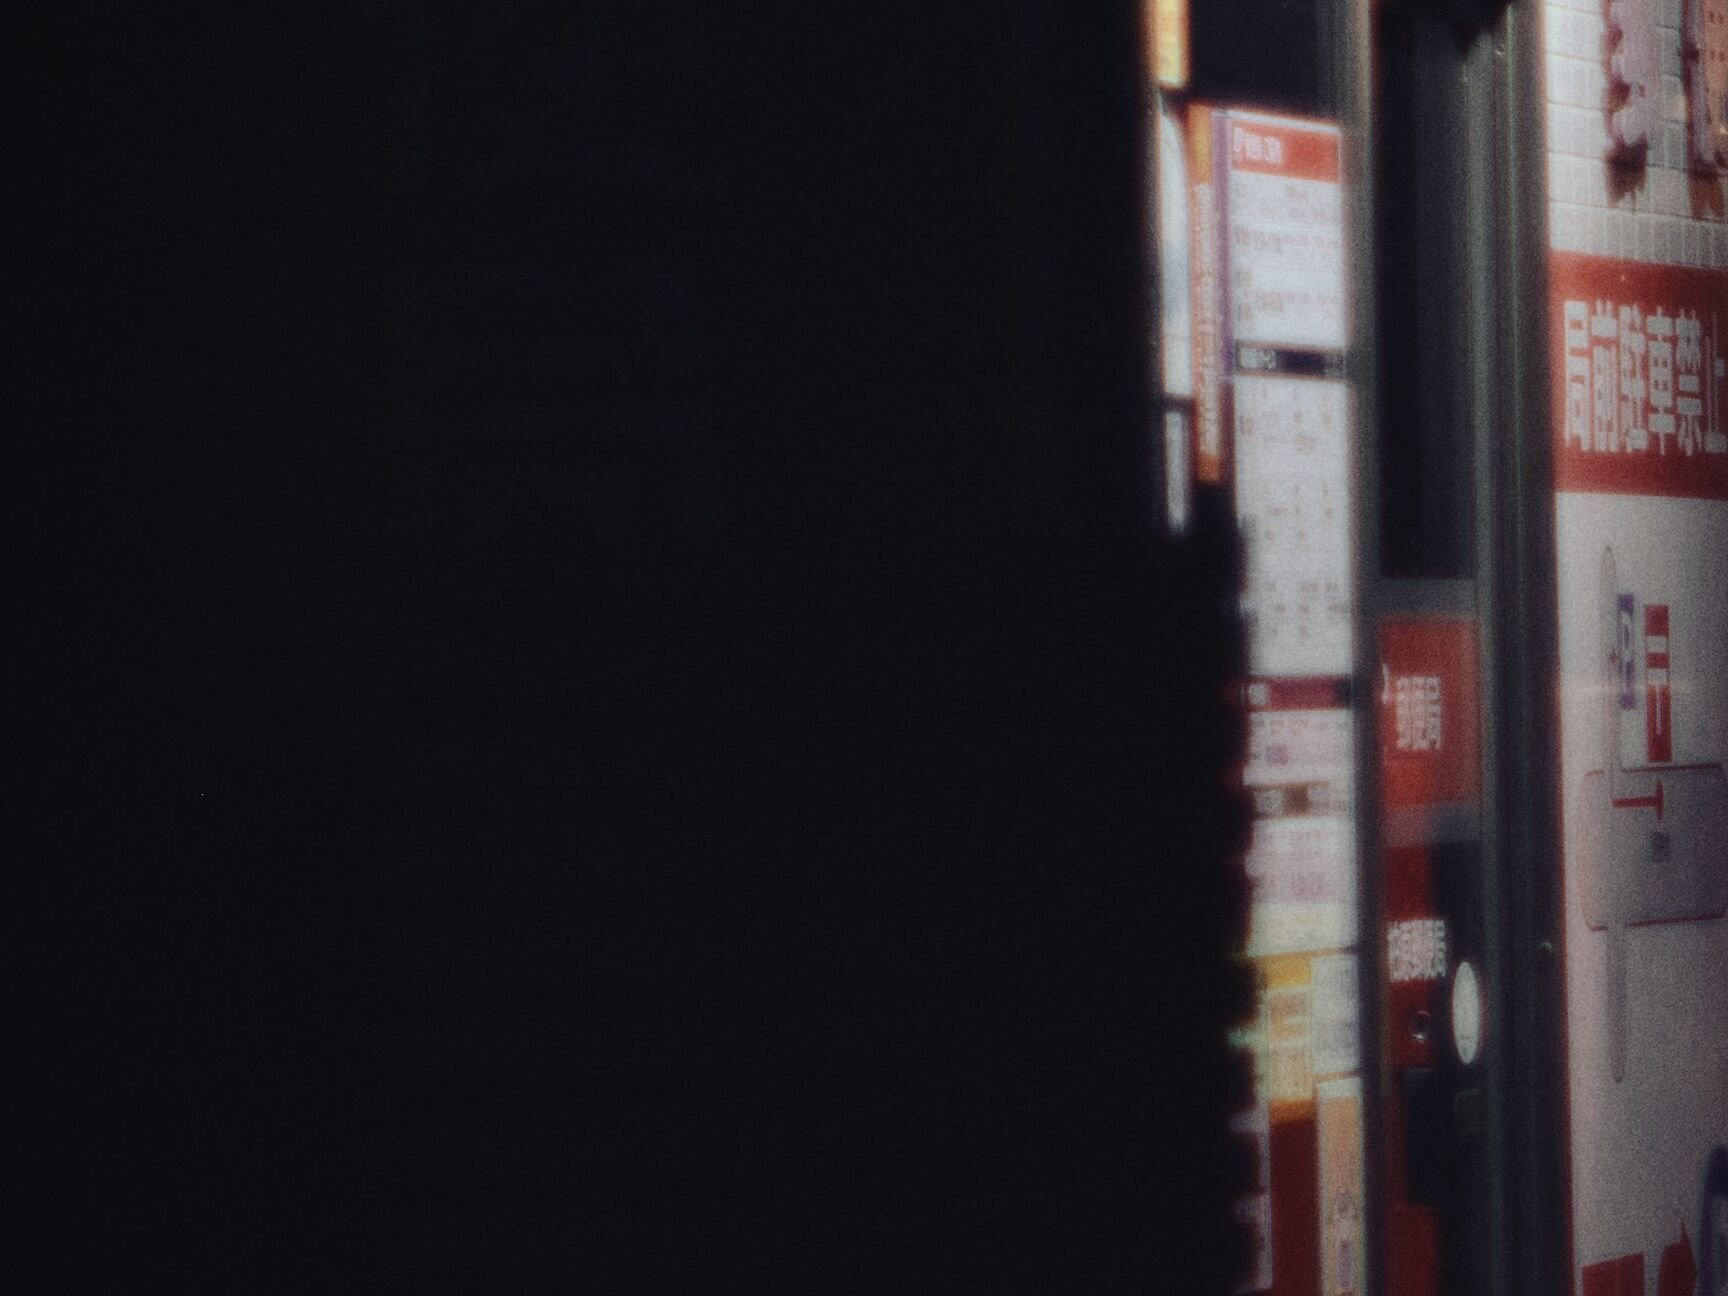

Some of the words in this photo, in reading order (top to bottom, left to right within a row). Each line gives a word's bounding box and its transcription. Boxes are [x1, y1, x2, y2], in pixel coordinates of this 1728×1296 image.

[1564, 298, 1728, 456] 局前駐車禁止
